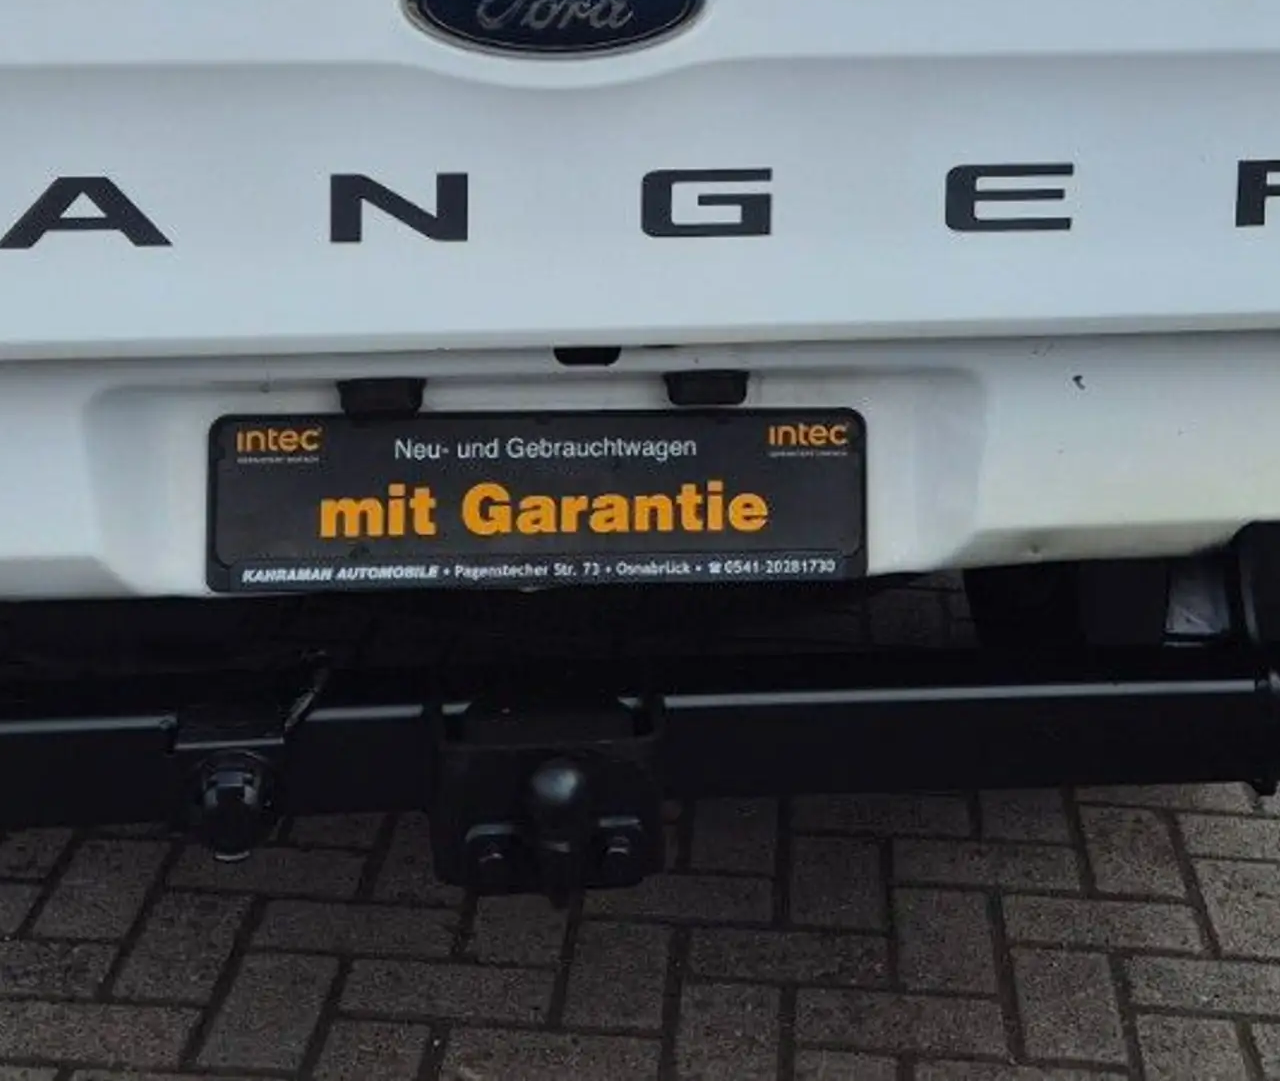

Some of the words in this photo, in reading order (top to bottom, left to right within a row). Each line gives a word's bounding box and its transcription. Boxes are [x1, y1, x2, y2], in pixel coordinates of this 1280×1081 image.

[237, 427, 320, 453] intec
[769, 421, 849, 446] intec
[395, 438, 449, 460] Neu-
[458, 438, 499, 459] und
[506, 435, 697, 461] Gebrauchtwagen
[320, 483, 436, 538] mit
[461, 480, 768, 535] Garantie
[336, 565, 440, 580] AUTOMOBILE
[553, 562, 577, 576] Str.
[582, 561, 600, 576] 73
[616, 560, 690, 575] Osnabrück
